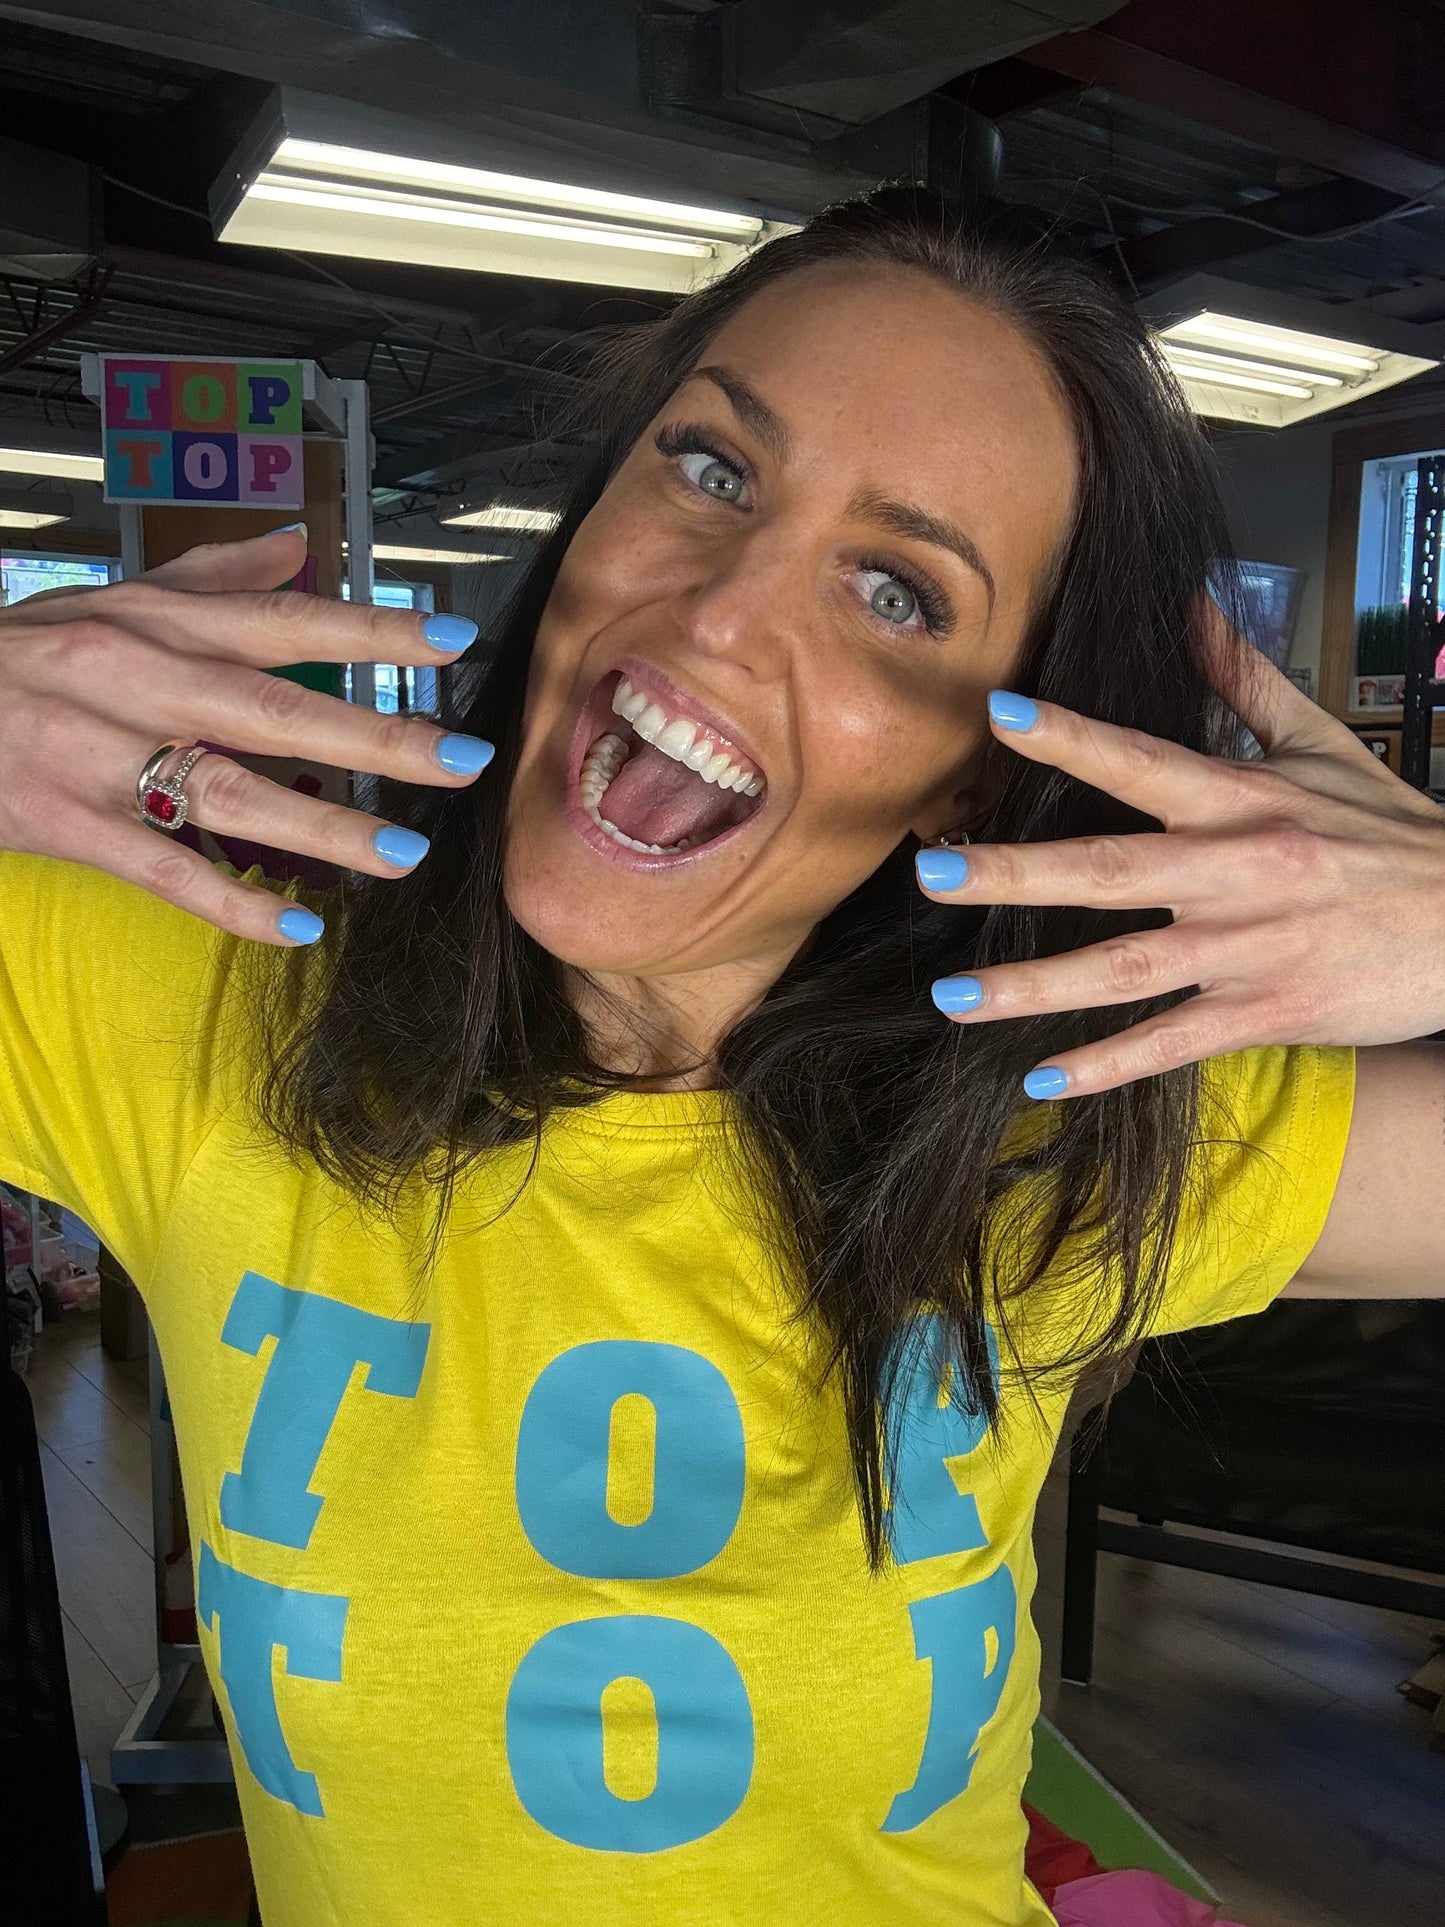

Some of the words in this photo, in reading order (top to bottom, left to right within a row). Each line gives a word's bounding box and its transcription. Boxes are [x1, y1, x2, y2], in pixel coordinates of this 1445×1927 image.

[114, 371, 290, 424] TOP
[117, 440, 292, 492] TOP
[221, 1270, 1000, 1580] TOP
[198, 1538, 1016, 1854] TOP
